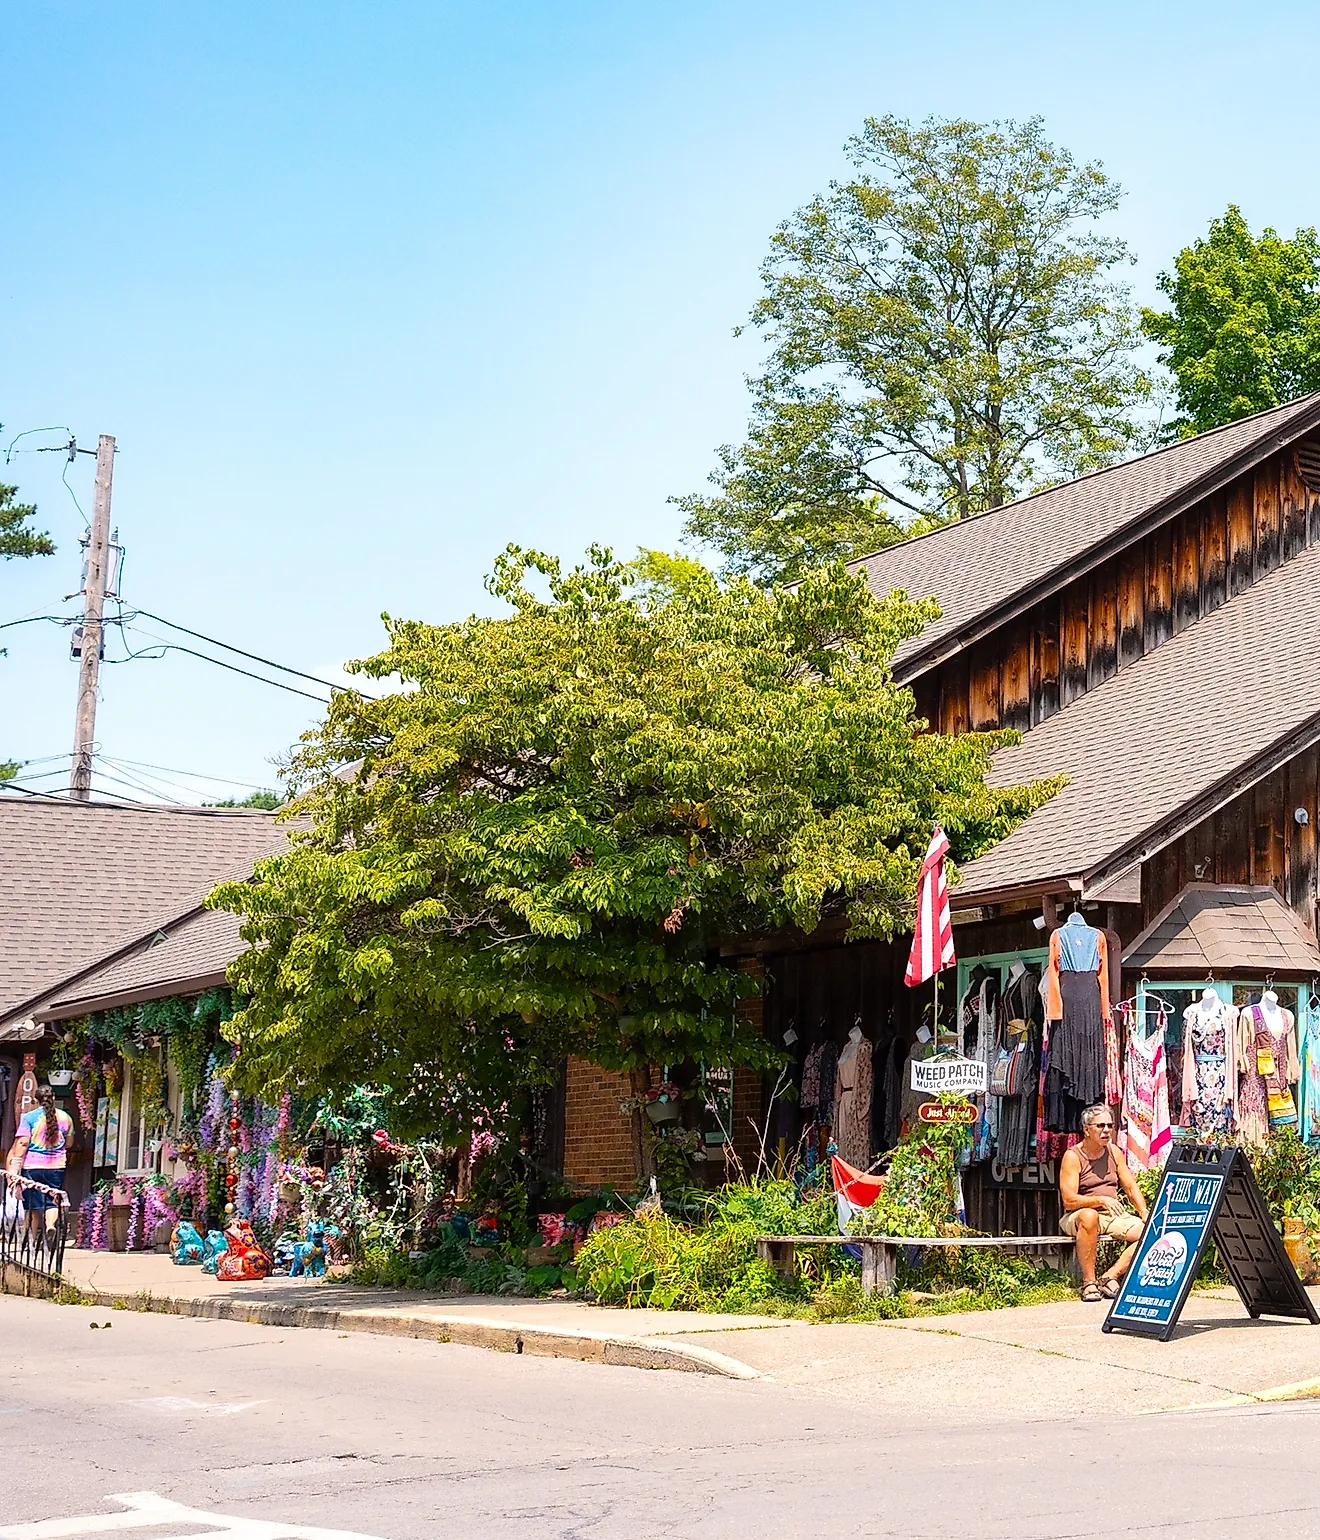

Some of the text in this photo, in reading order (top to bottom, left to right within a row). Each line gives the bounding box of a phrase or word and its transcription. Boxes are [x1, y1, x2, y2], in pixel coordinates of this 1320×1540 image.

[914, 1063, 984, 1081] WEED PATCH
[916, 1078, 984, 1089] MUSIC COMPANY
[926, 1107, 944, 1119] Just
[1170, 1177, 1220, 1205] THIS WAY
[1148, 1247, 1183, 1266] Weed
[1140, 1265, 1176, 1287] Patch
